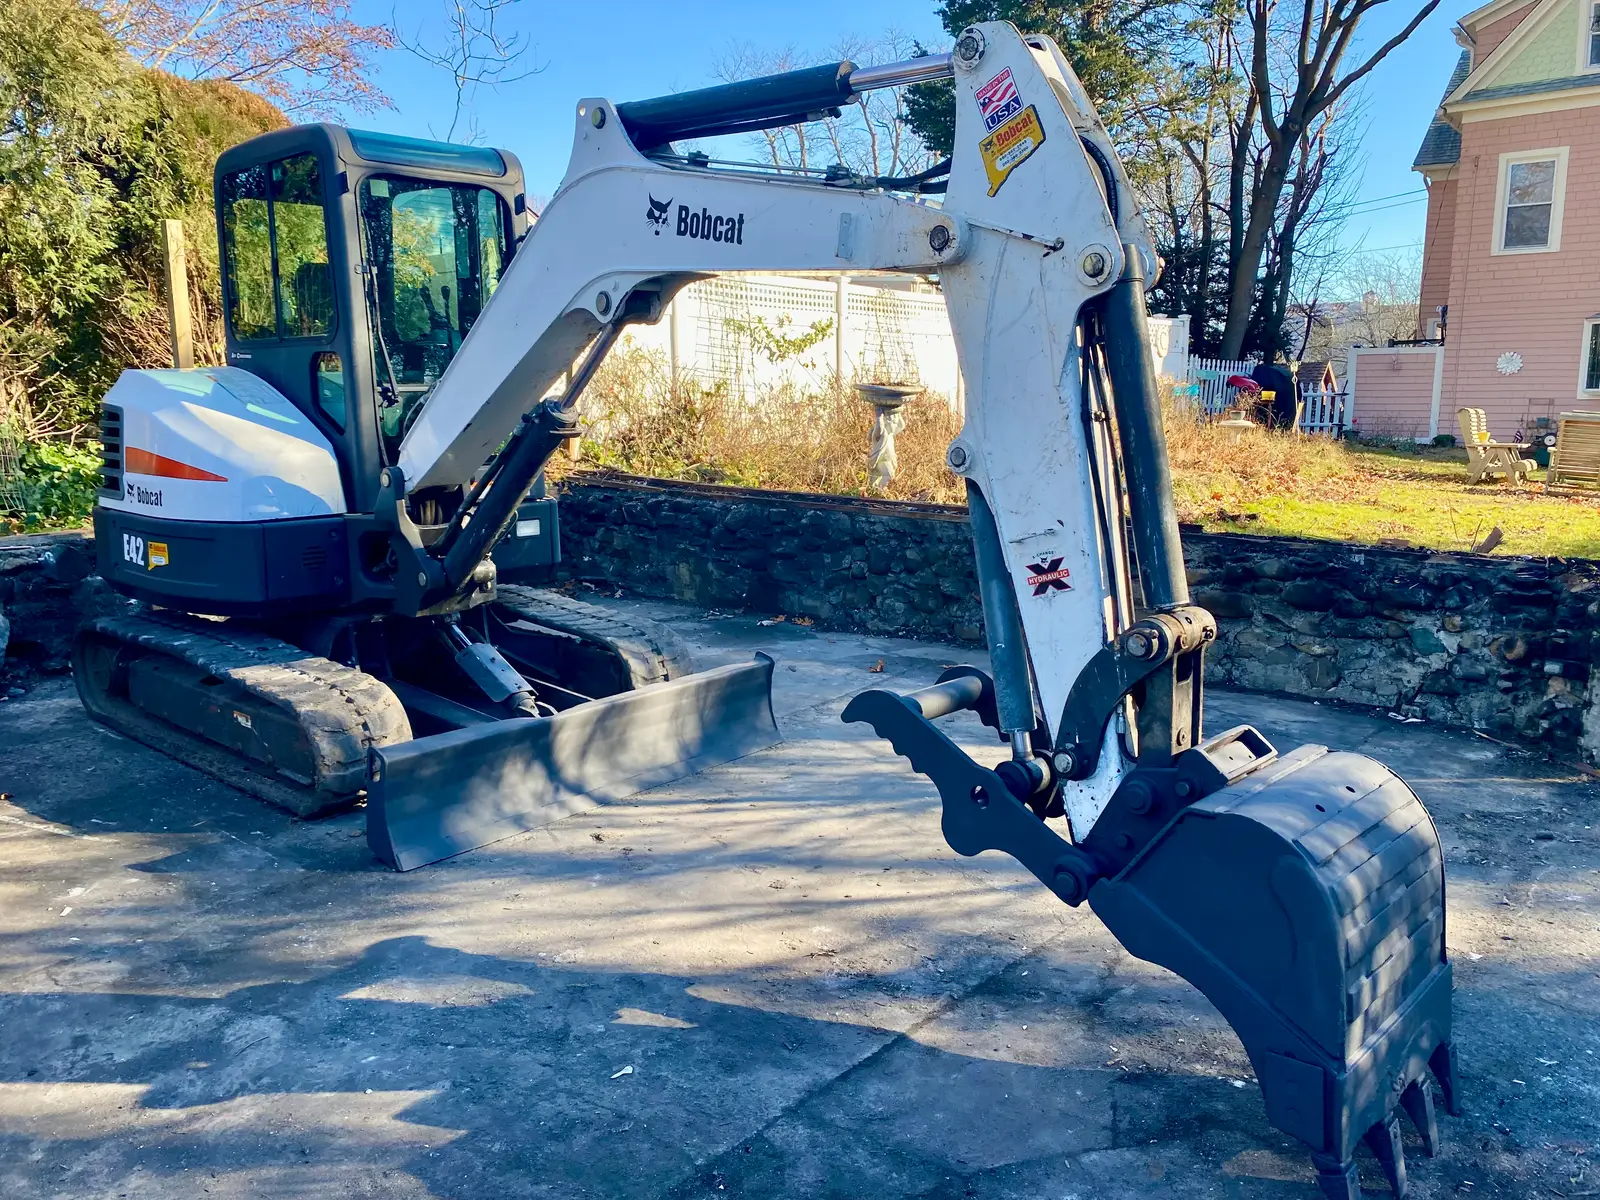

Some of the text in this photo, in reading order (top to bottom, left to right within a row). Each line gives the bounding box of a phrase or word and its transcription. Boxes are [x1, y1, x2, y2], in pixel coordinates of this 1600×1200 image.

[977, 83, 993, 98] MADE
[998, 71, 1010, 82] THE
[987, 101, 1020, 127] USA
[995, 113, 1033, 146] Bobcat
[676, 205, 745, 245] Bobcat
[136, 486, 163, 507] Bobcat
[123, 533, 145, 566] E42
[1028, 570, 1069, 585] HYDRAULIC
